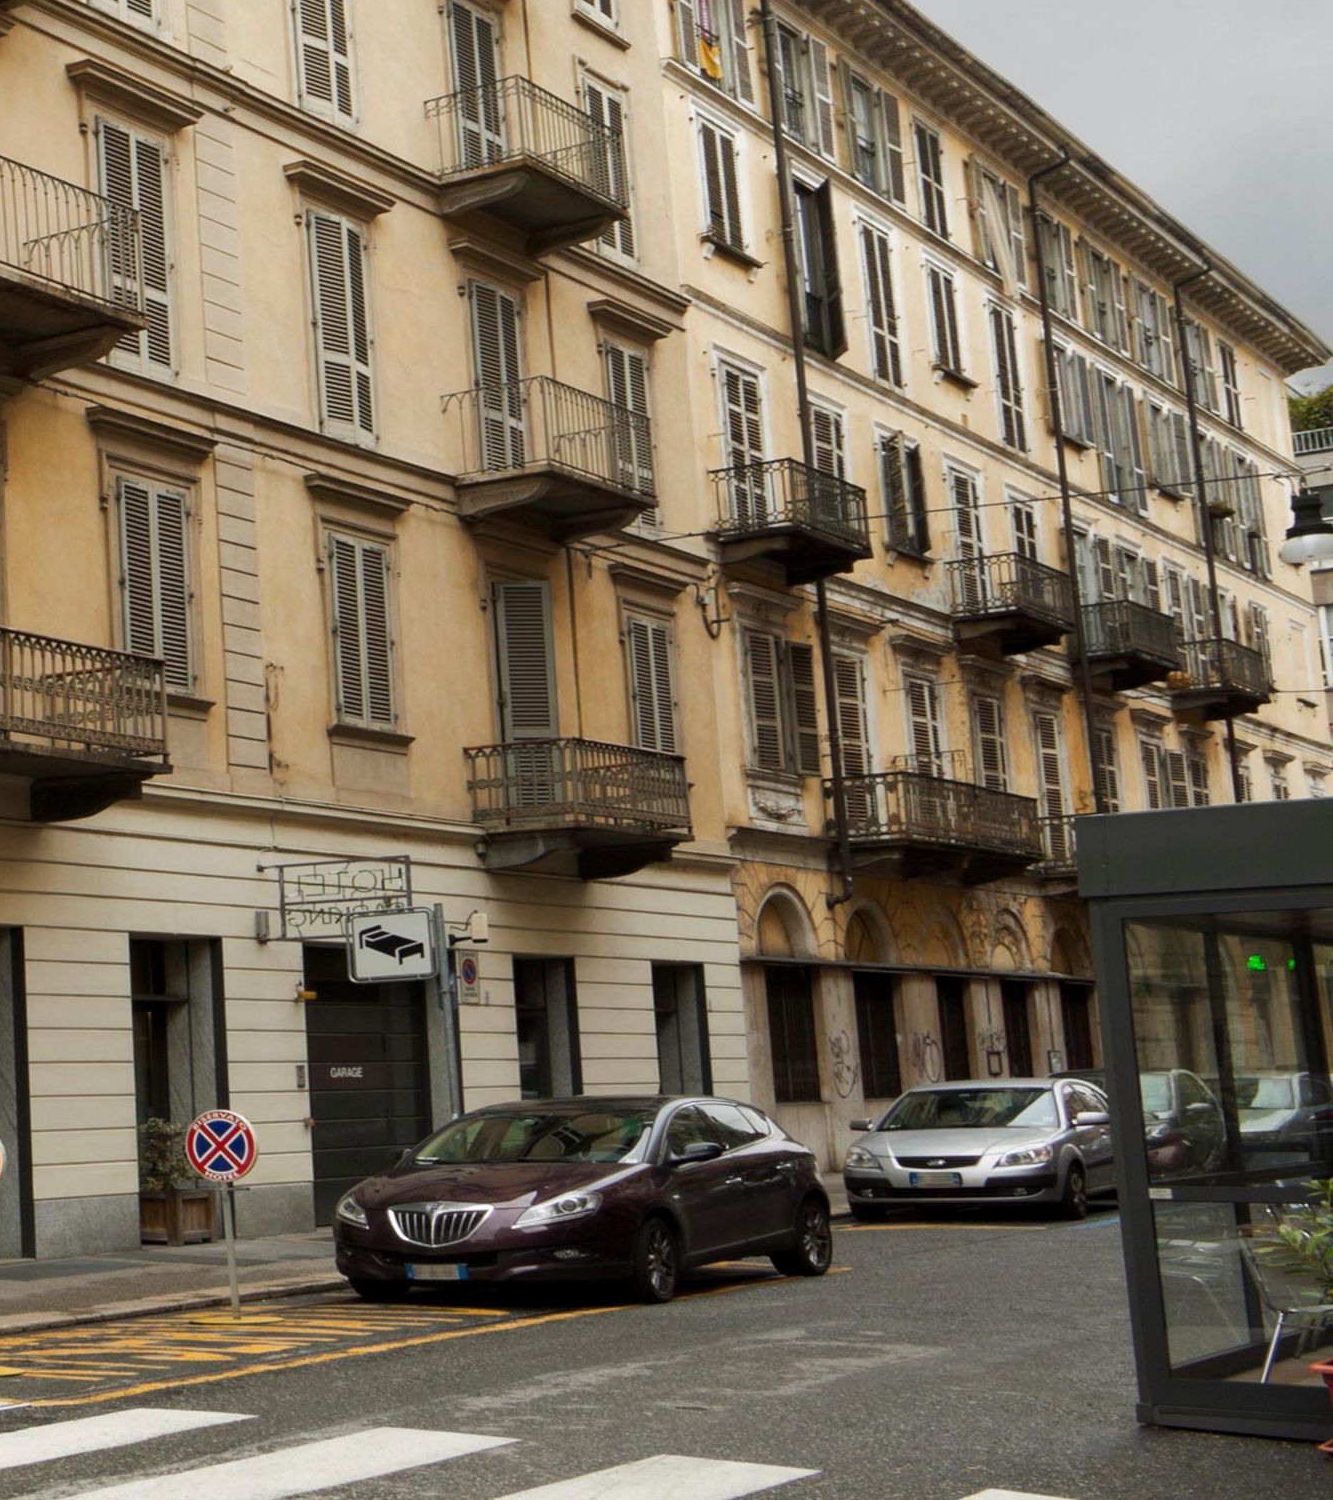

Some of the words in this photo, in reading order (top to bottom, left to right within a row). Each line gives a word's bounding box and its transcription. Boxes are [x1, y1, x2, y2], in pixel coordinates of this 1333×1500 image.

[330, 1067, 363, 1078] GARAGE
[193, 1112, 247, 1131] RISERVATO
[205, 1170, 240, 1181] HOTEL
